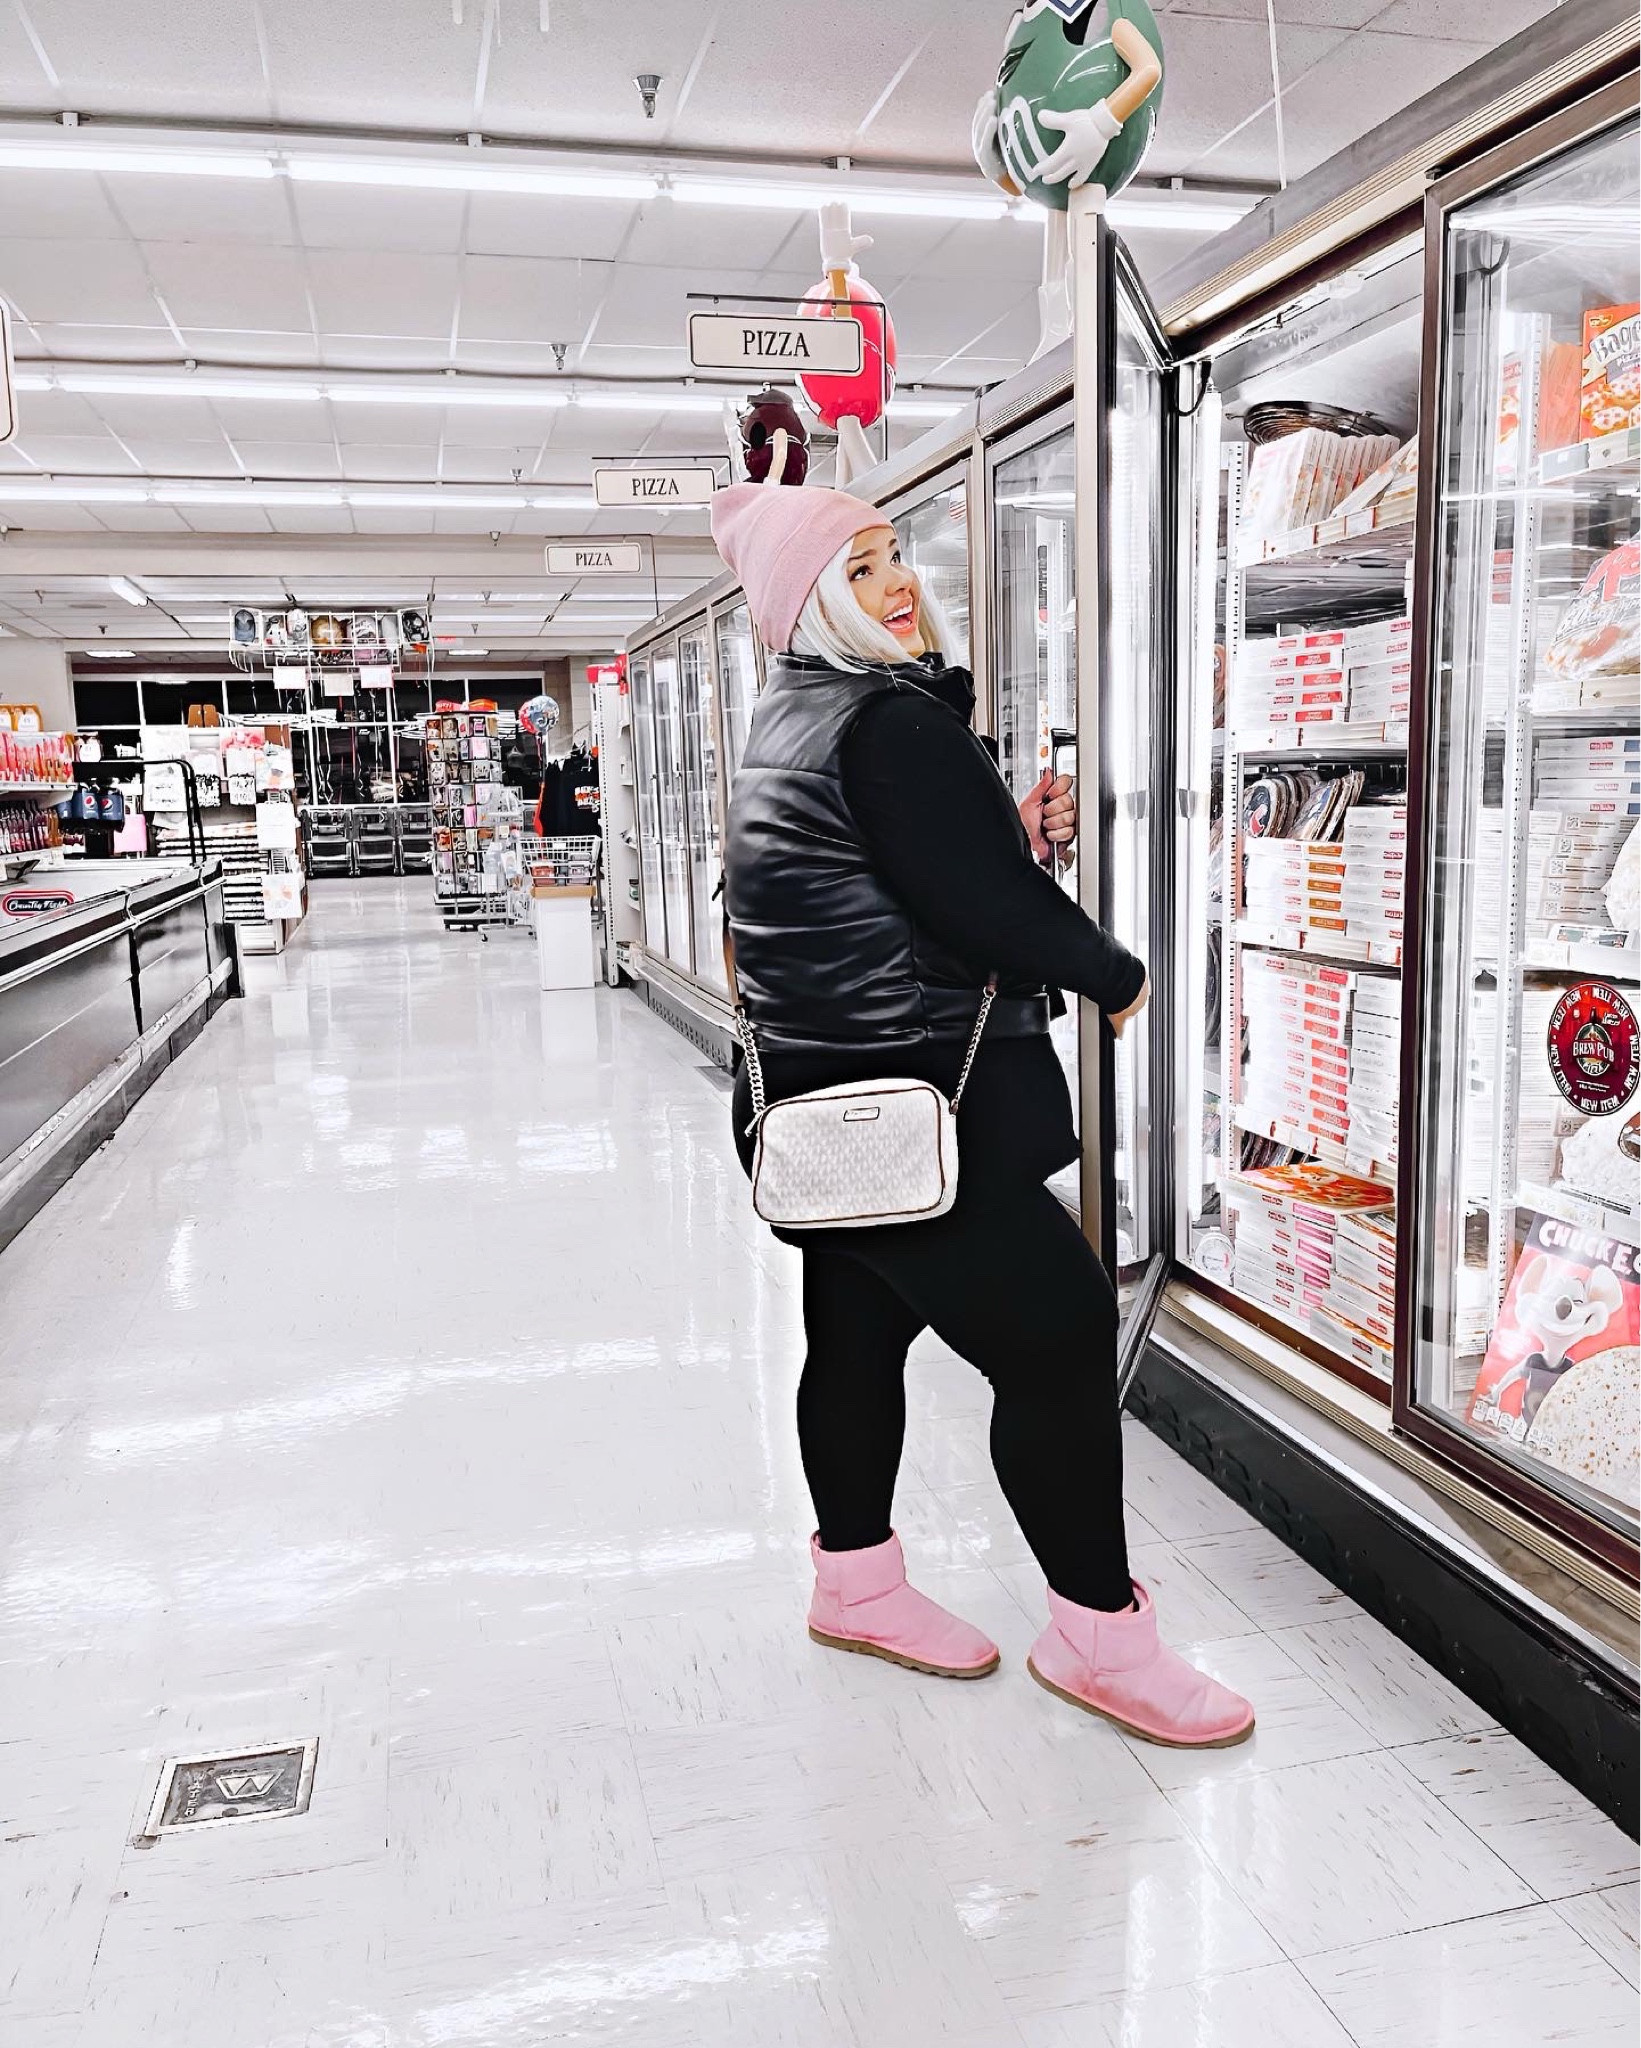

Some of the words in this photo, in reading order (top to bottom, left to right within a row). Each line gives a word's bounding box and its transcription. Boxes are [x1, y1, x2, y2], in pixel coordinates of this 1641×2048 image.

[742, 329, 811, 358] PIZZA
[631, 477, 680, 496] PIZZA
[575, 552, 613, 566] PIZZA
[1566, 989, 1581, 1008] NEW
[1592, 986, 1612, 1003] ITEM
[1552, 1006, 1567, 1031] ITEM
[1611, 998, 1630, 1021] NEW
[1572, 1041, 1596, 1057] BREW
[1597, 1041, 1615, 1063] PUB
[1550, 1043, 1562, 1067] NEW
[1556, 1071, 1573, 1096] ITEM
[1624, 1064, 1639, 1091] NEW
[1580, 1096, 1598, 1113] NEW
[1600, 1095, 1620, 1112] ITEM
[1539, 1220, 1616, 1263] CHUCK
